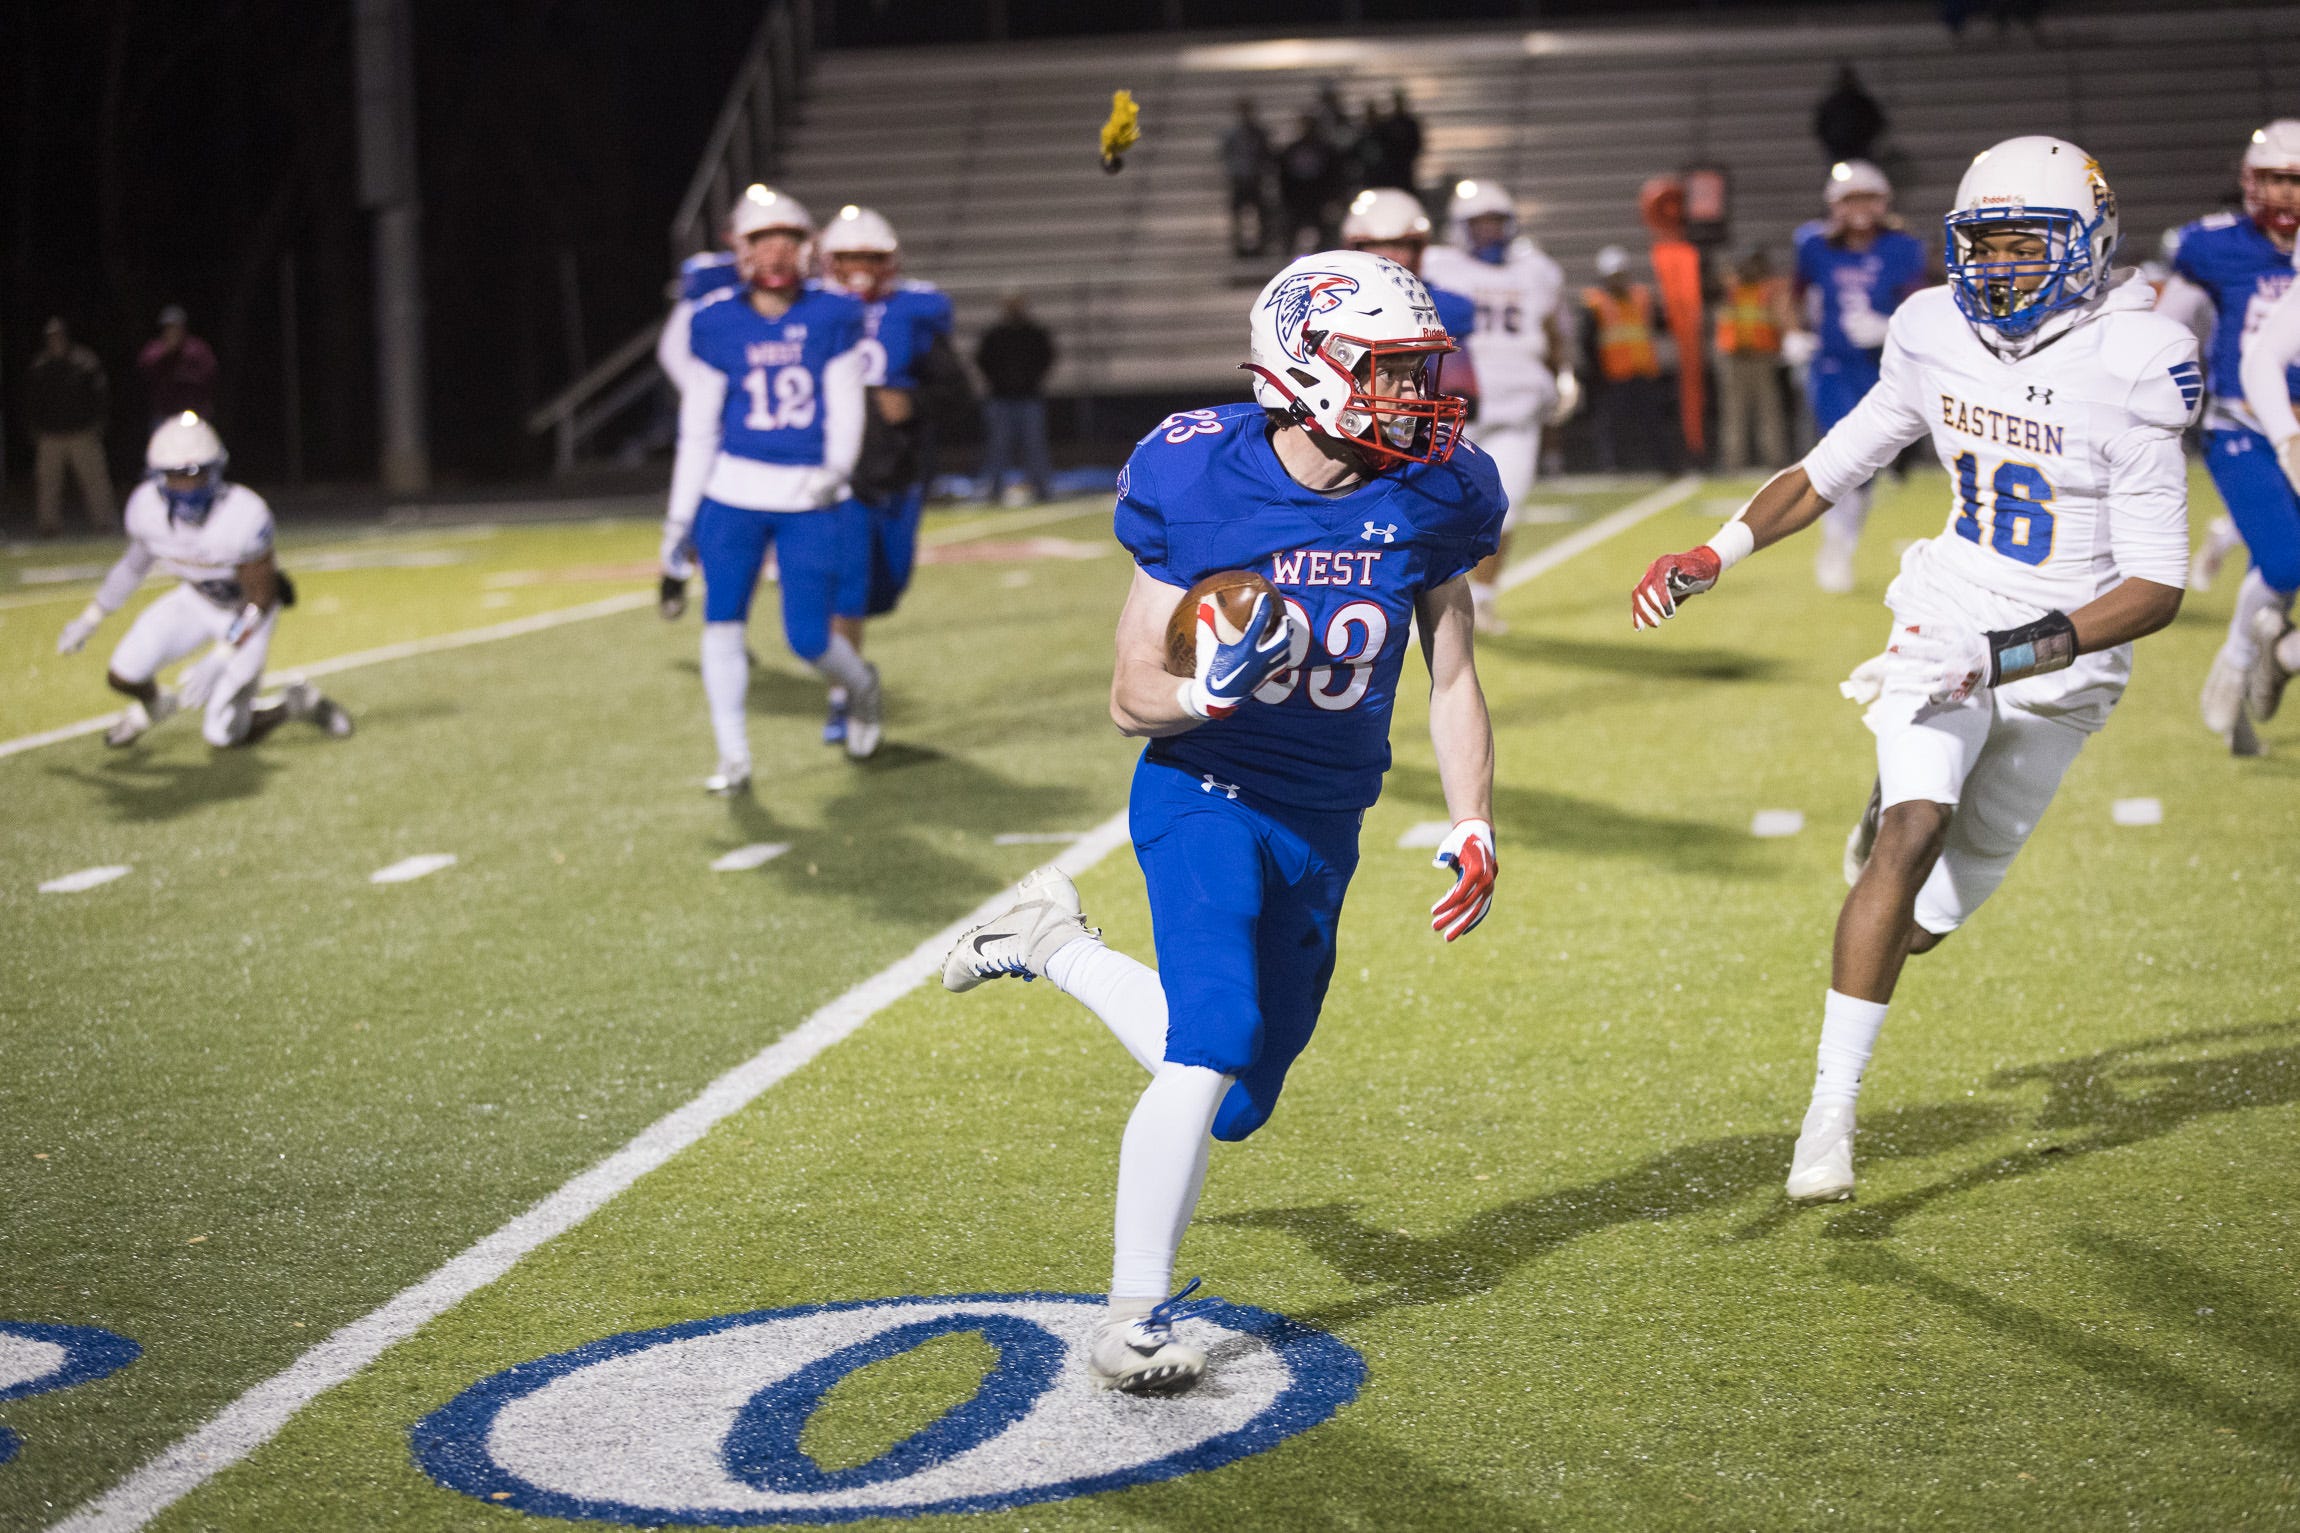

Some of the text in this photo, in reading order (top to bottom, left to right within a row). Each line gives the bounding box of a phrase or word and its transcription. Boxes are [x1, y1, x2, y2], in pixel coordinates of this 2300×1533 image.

[742, 365, 817, 431] 12
[1941, 394, 2065, 456] EASTERN
[1952, 449, 2058, 568] 16
[1272, 550, 1383, 587] WEST
